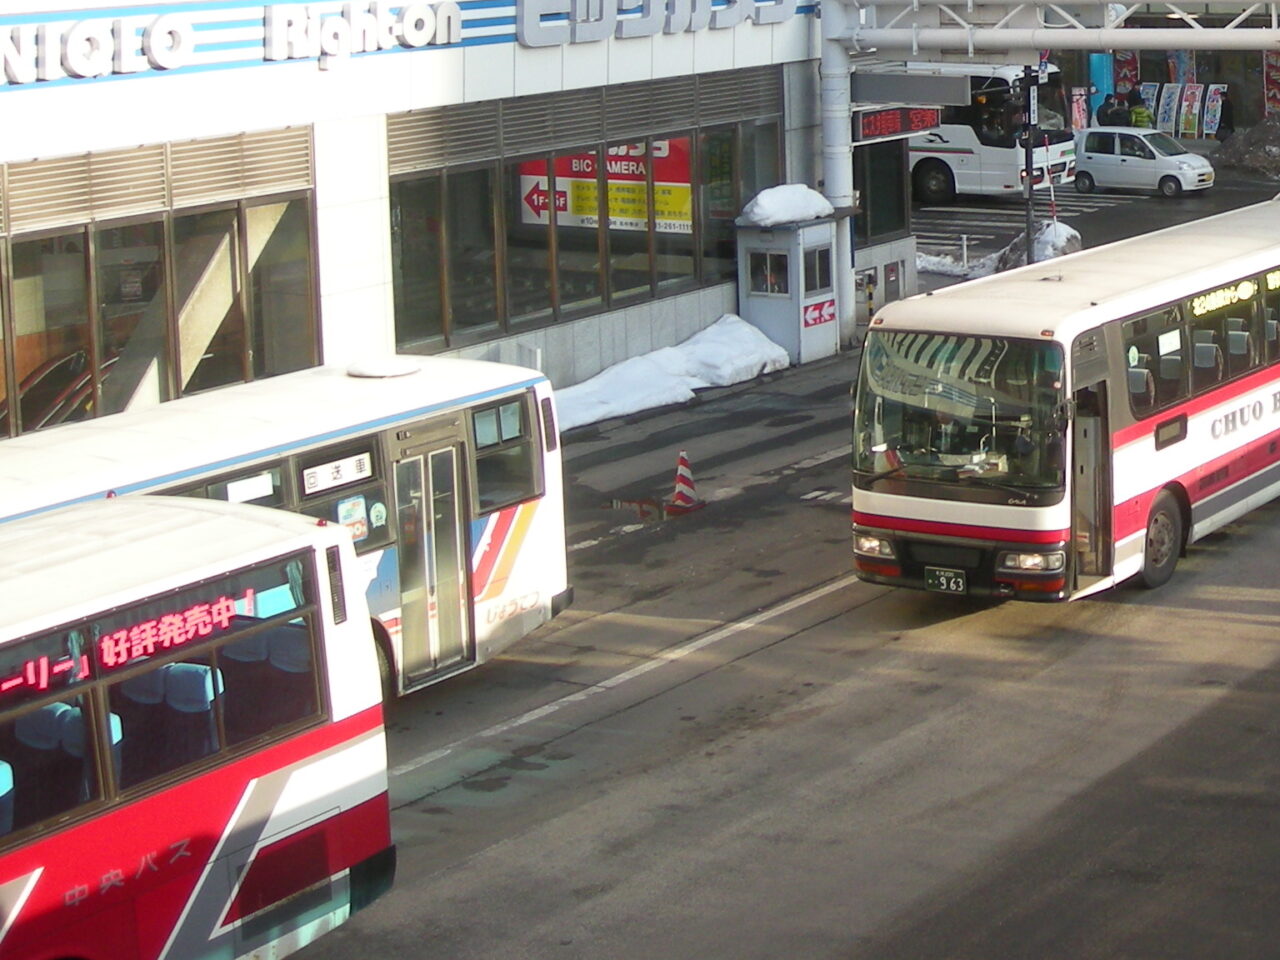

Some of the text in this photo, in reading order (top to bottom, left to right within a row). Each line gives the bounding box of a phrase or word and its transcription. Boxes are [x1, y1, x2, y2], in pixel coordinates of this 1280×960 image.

[572, 159, 646, 174] BIC AMERA
[1210, 400, 1264, 440] CHUO
[306, 458, 367, 490] 回送車
[940, 576, 963, 591] 963
[64, 839, 191, 907] 中央バス
